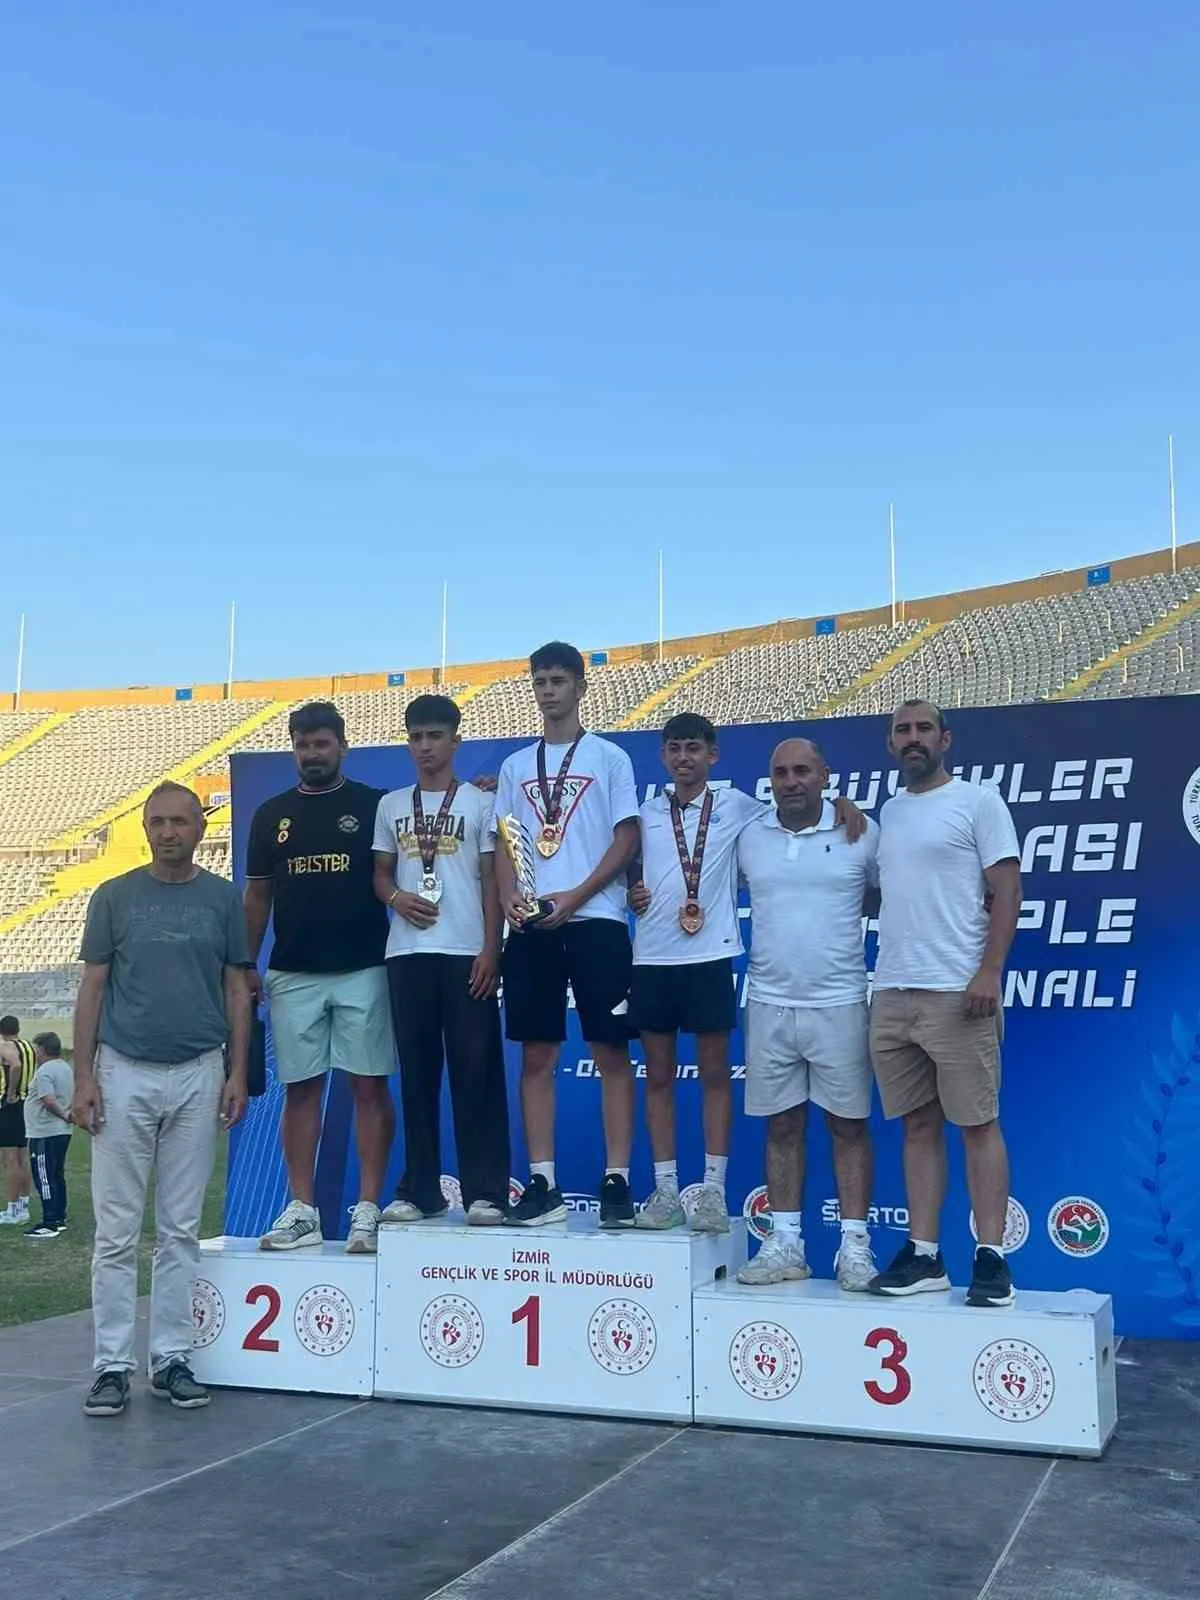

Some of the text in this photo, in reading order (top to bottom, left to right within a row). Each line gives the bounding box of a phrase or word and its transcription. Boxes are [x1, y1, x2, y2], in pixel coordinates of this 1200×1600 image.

[395, 814, 465, 842] FLRDA
[1020, 822, 1143, 873] ASI
[421, 1265, 654, 1290] GENÇLİK VE SPOR İL MÜDÜRLÜĞÜ
[512, 1248, 550, 1264] İZMİR
[242, 1284, 281, 1353] 2
[511, 1295, 540, 1366] 1
[863, 1327, 911, 1406] 3
